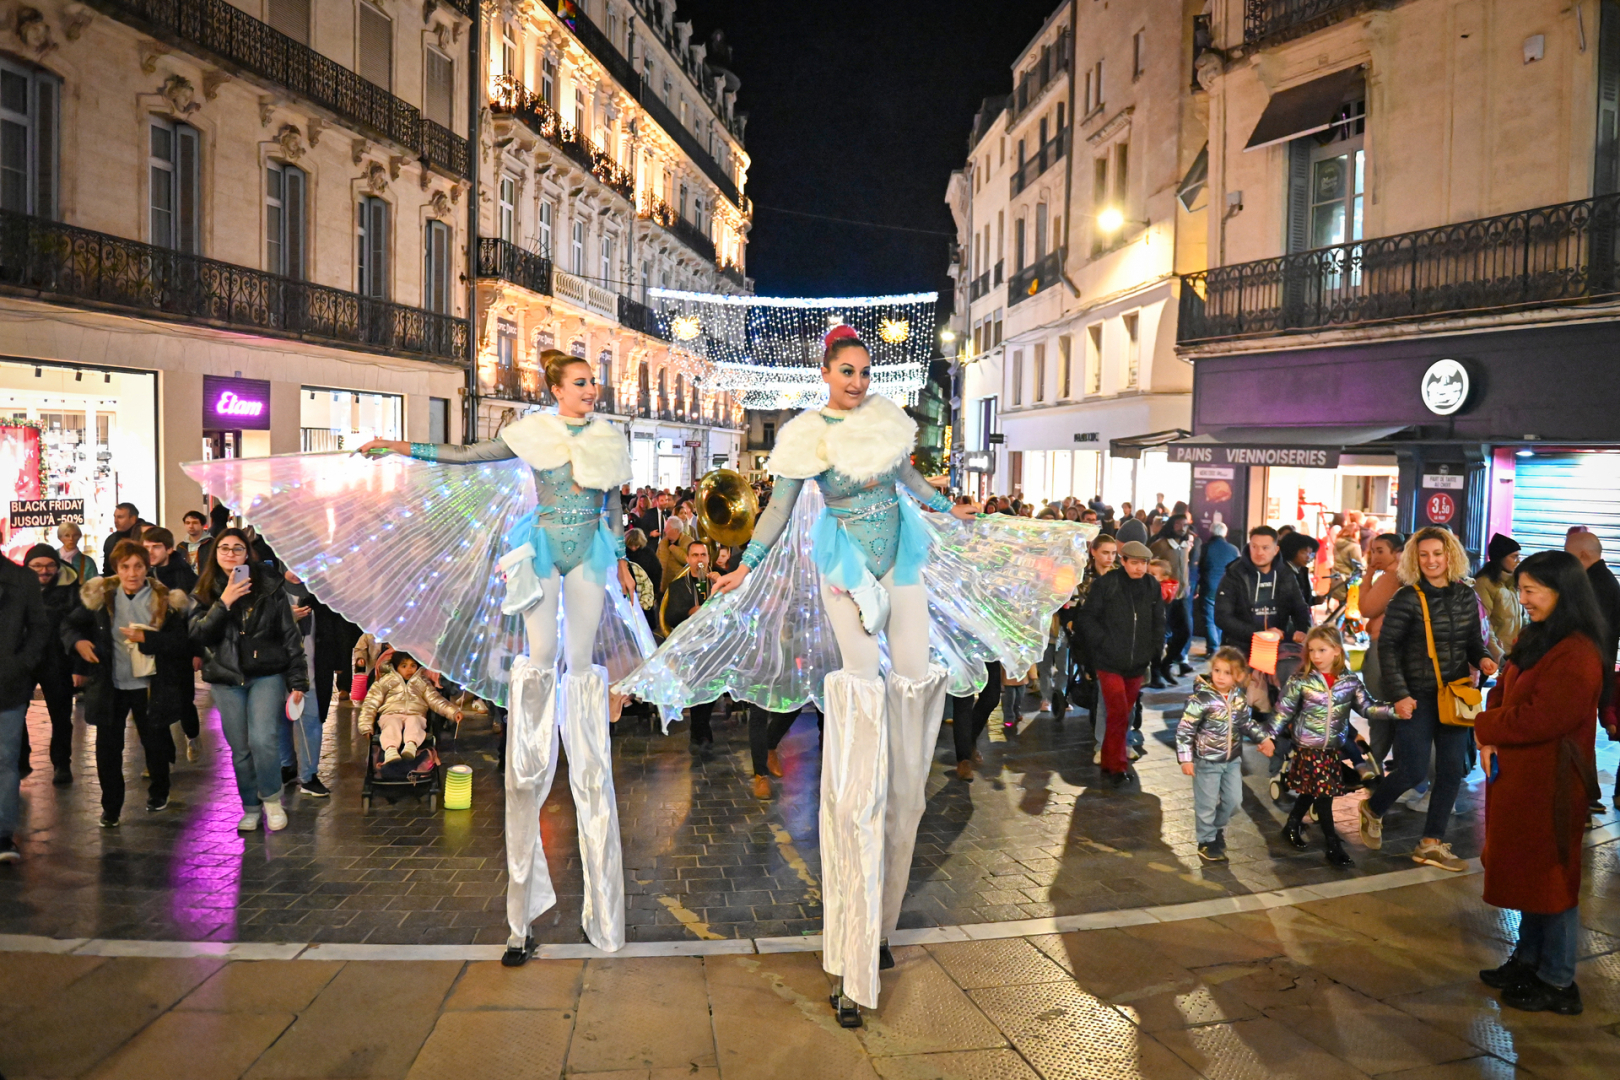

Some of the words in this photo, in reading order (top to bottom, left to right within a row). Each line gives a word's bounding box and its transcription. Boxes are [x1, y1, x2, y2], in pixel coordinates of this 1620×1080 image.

[216, 391, 263, 416] Etam
[1176, 447, 1212, 462] PAINS
[1226, 448, 1327, 466] VIENNOISERIES
[11, 500, 47, 512] BLACK
[49, 499, 83, 511] FRIDAY
[11, 512, 56, 527] JUSQU'À
